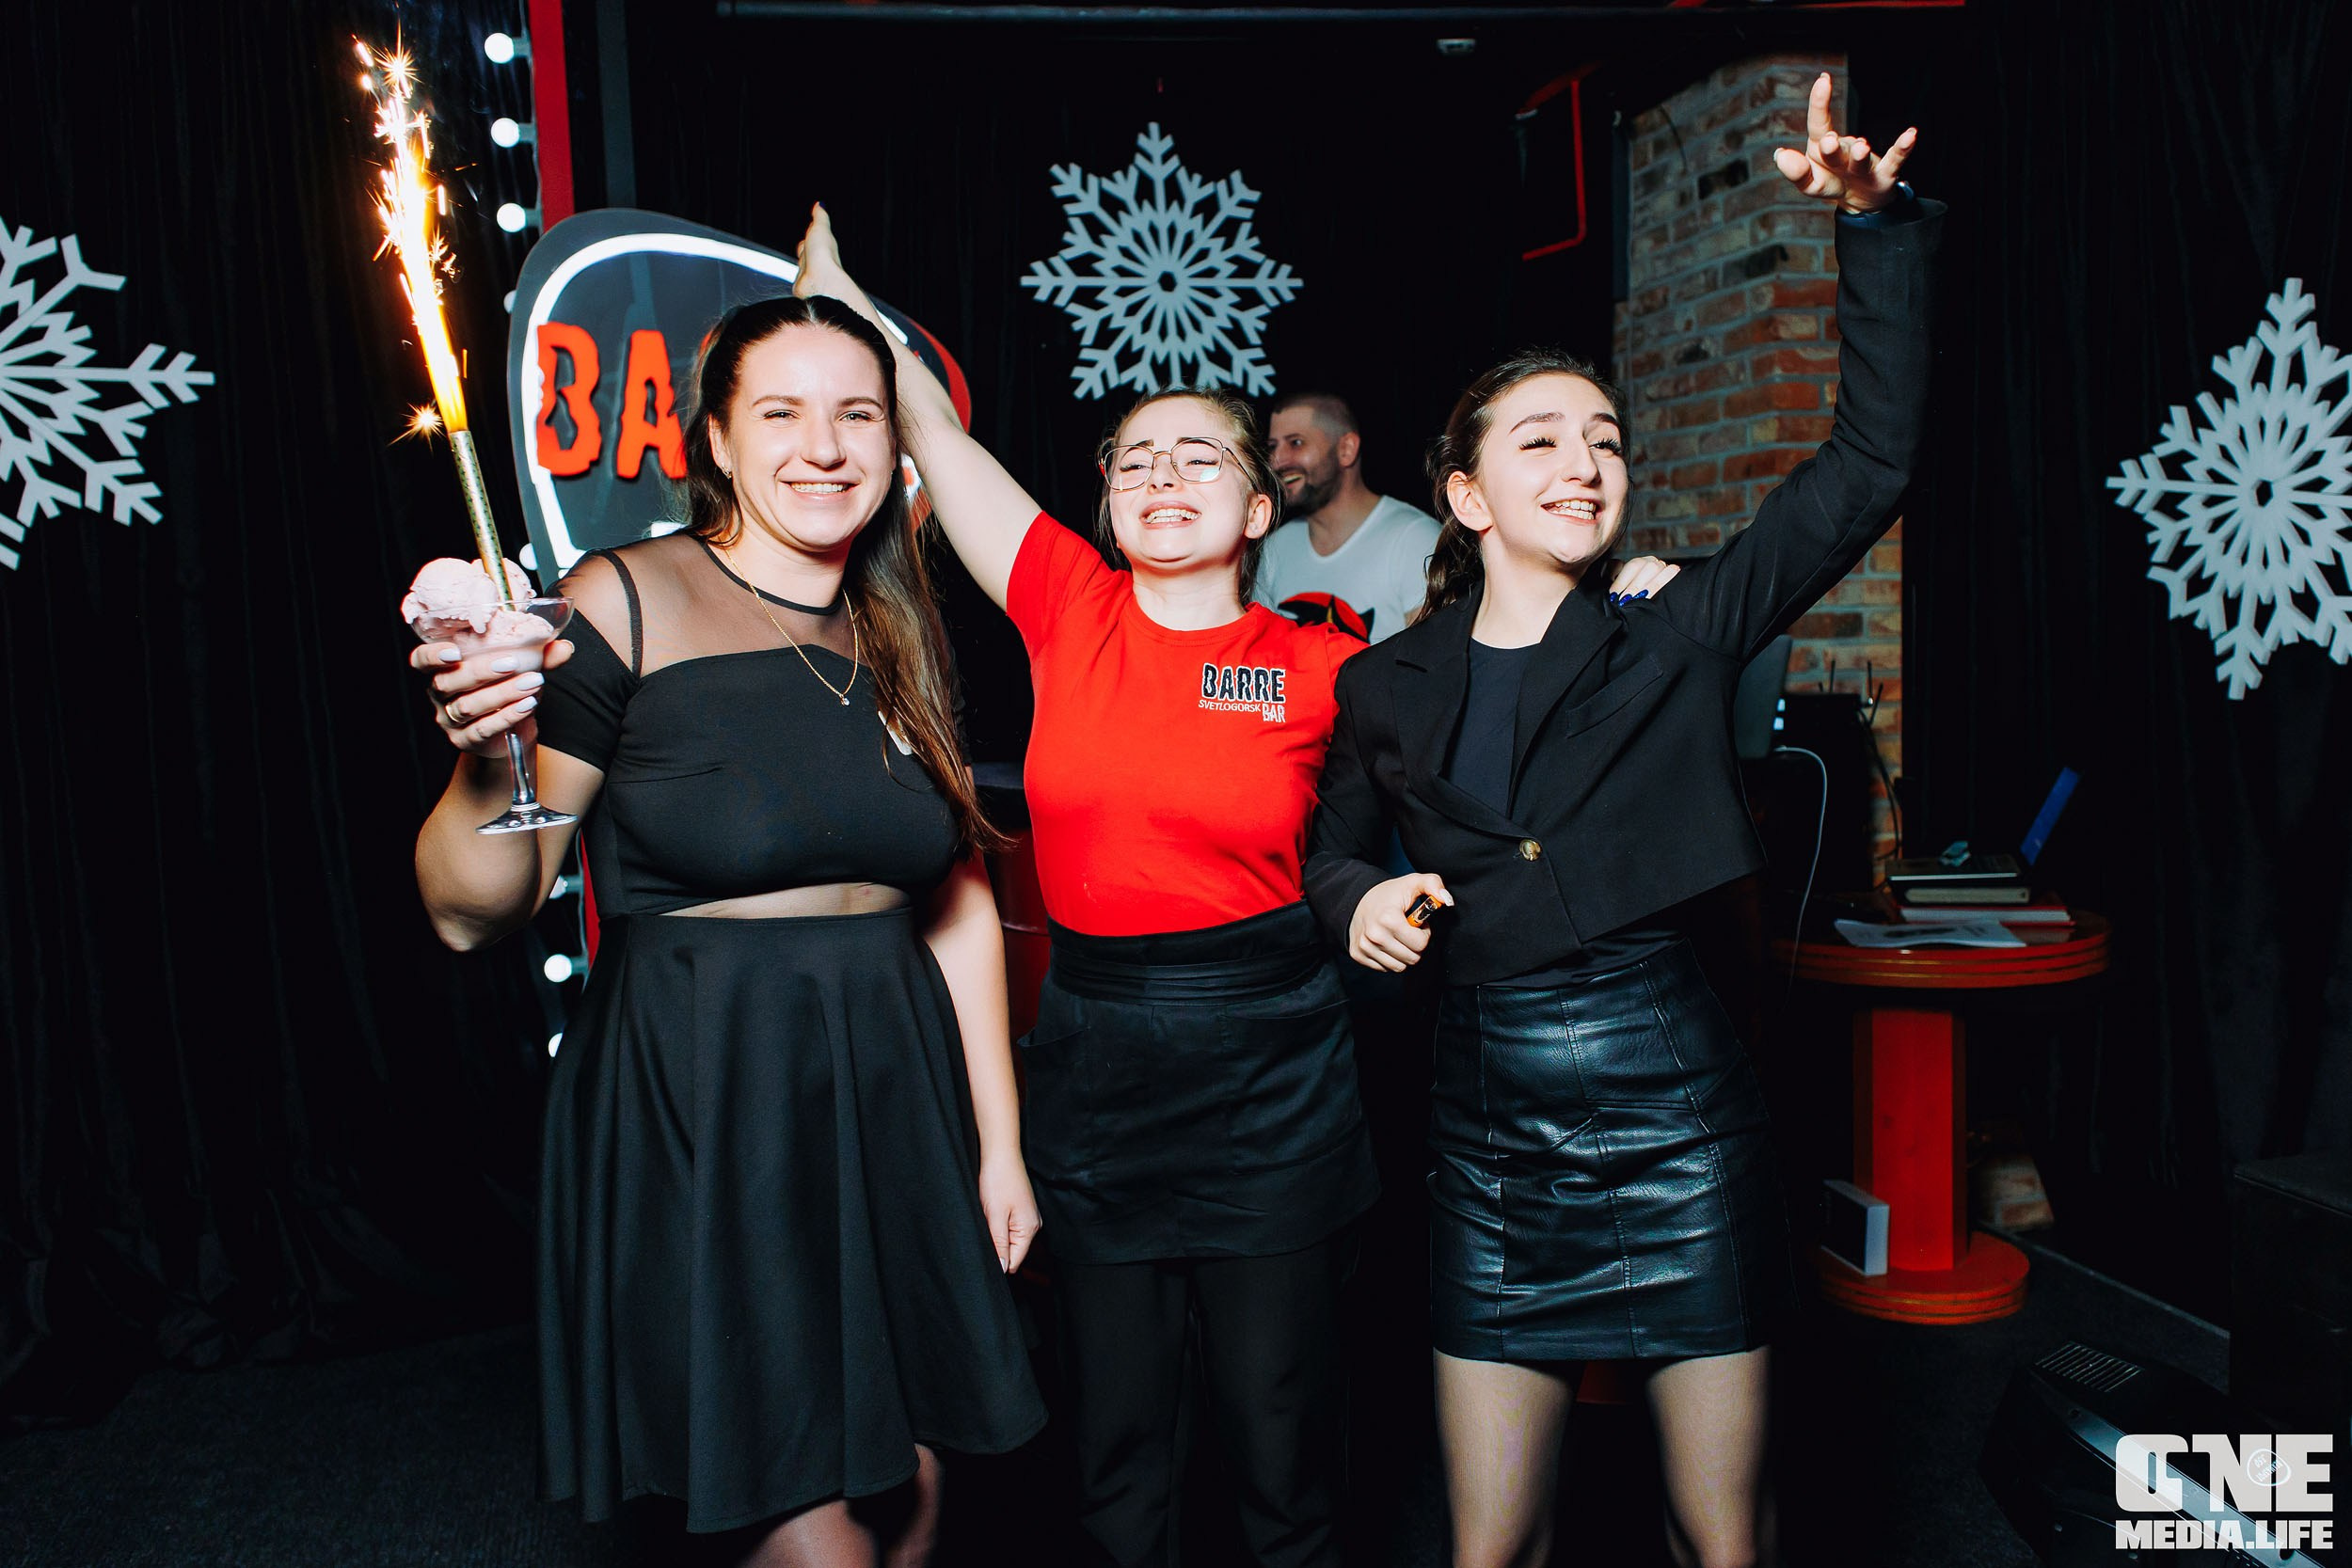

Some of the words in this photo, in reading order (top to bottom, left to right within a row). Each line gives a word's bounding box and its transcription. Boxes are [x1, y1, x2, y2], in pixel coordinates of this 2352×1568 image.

[537, 322, 713, 479] BA
[1201, 663, 1286, 704] BARRE
[1199, 699, 1262, 713] SVETLOGORSK
[1262, 704, 1286, 723] BAR
